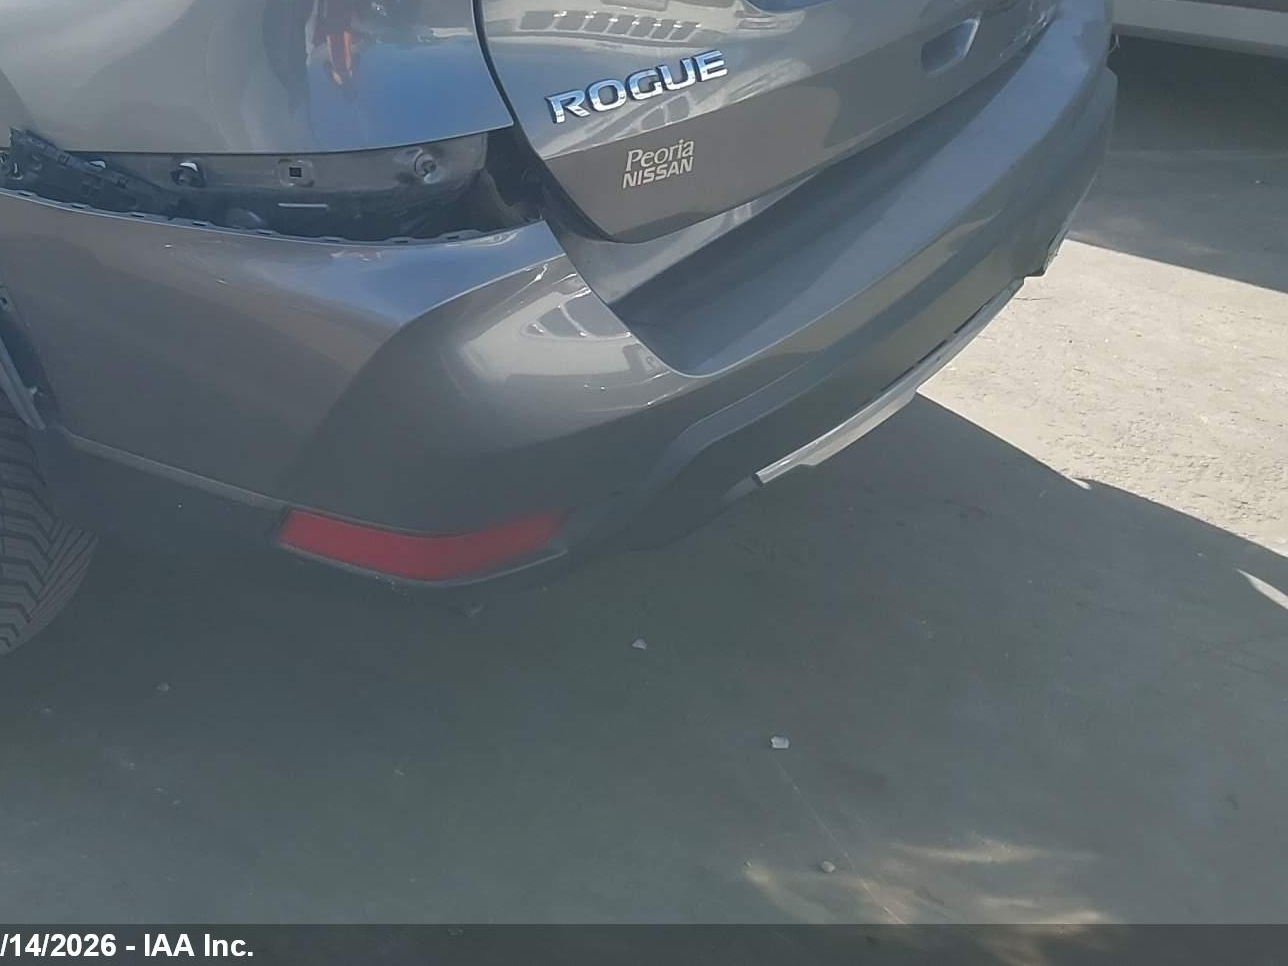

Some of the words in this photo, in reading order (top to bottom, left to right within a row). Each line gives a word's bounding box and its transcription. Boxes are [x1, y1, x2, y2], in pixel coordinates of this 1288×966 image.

[545, 50, 729, 124] ROGUE
[625, 138, 695, 172] Peoria
[622, 156, 695, 189] NISSAN
